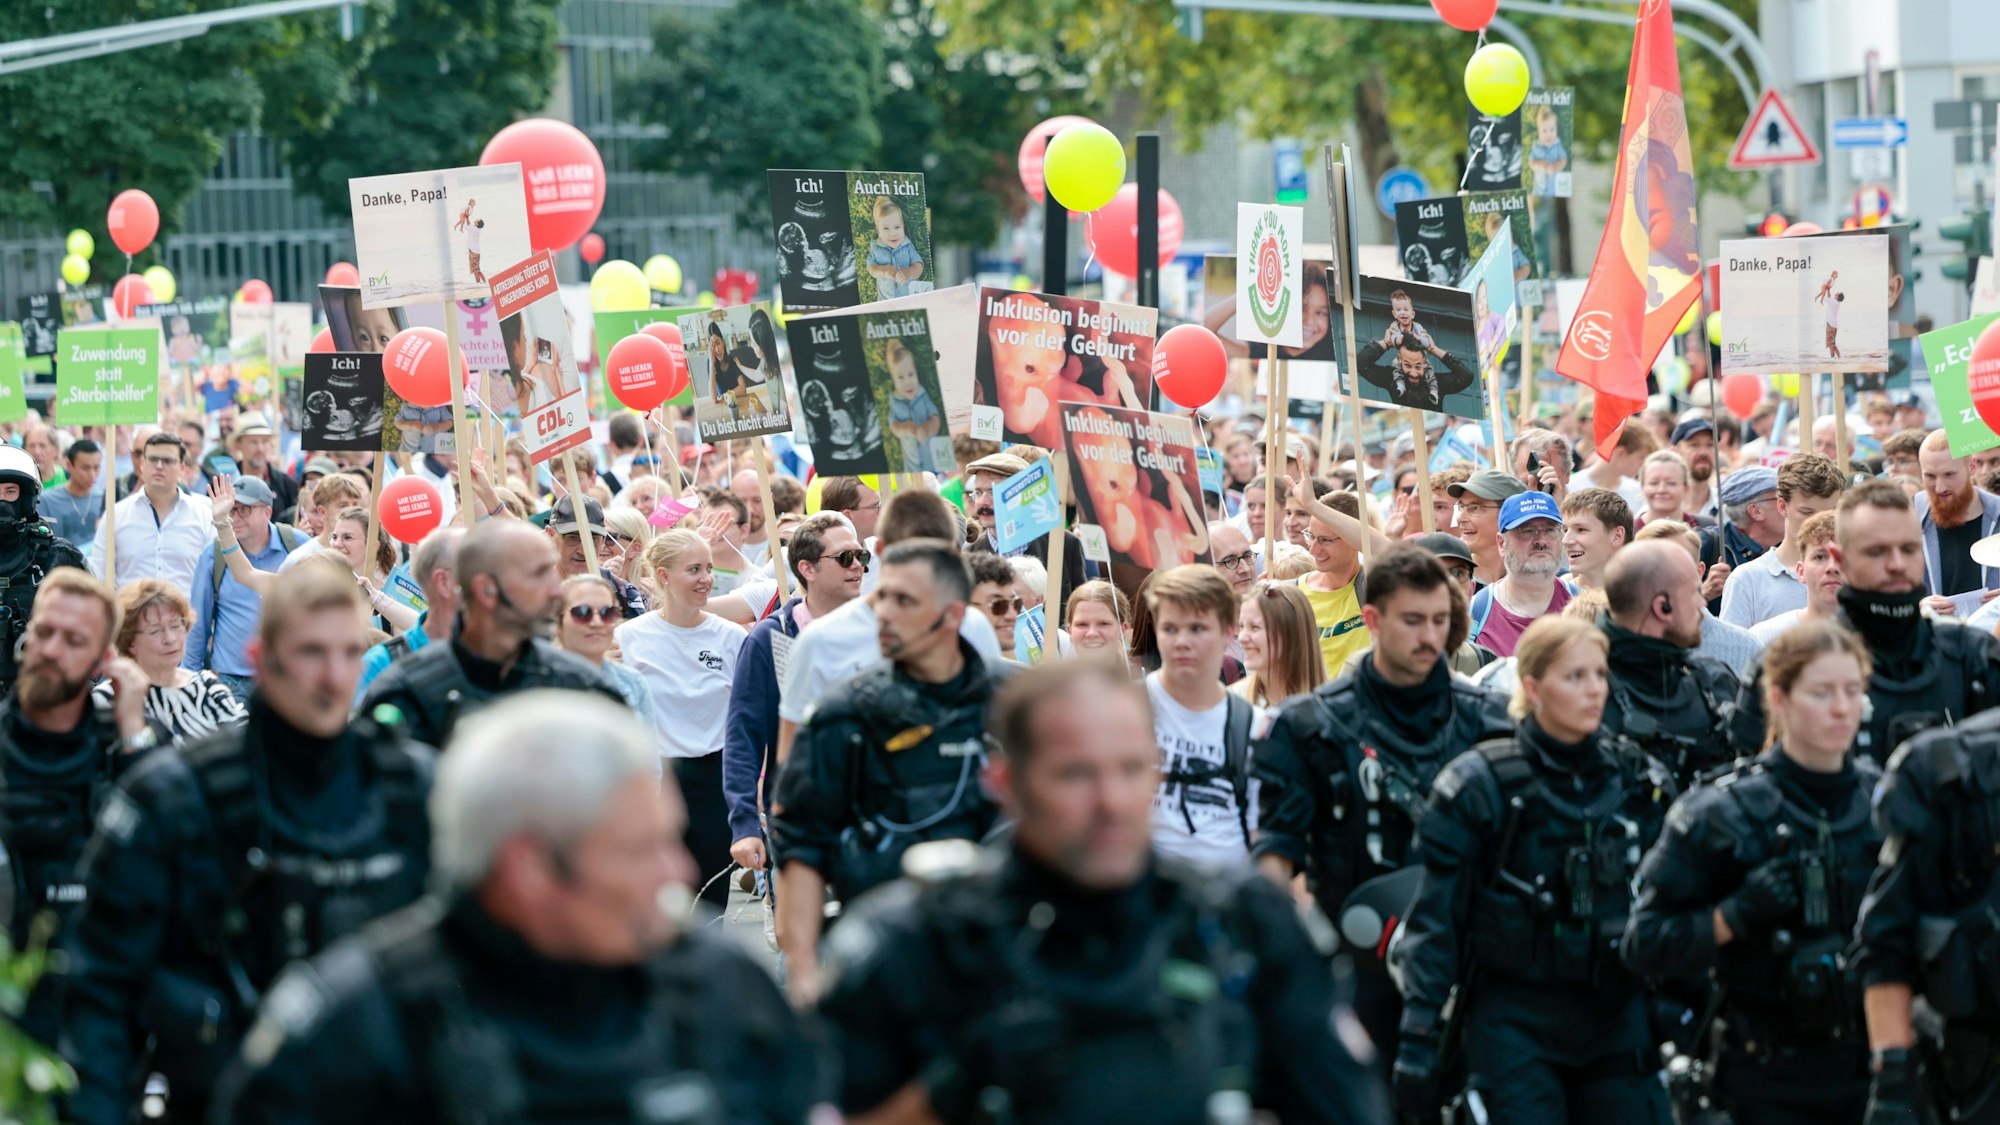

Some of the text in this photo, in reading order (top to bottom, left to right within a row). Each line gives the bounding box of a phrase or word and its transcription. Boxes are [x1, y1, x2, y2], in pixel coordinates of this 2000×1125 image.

[1552, 92, 1570, 106] ich!
[795, 178, 824, 193] Ich!
[854, 180, 919, 196] Auch ich!
[362, 186, 447, 207] Danke, Papa!
[1418, 203, 1444, 219] Ich!
[1469, 197, 1524, 213] Auch ich!
[1249, 210, 1290, 277] THANK YOU MOM!
[539, 258, 550, 272] EIN
[1730, 256, 1811, 272] Danke, Papa!
[534, 274, 550, 289] KIND
[986, 296, 1150, 337] Inklusion beginnt
[810, 324, 840, 344] Ich!
[865, 317, 926, 339] Auch ich!
[997, 328, 1136, 362] vor der Geburt
[71, 342, 146, 365] Zuwendung
[331, 358, 360, 370] Ich!
[619, 362, 652, 374] WIR LIEBEN
[95, 366, 122, 382] statt
[620, 372, 654, 384] DAS LEBEN!
[537, 406, 566, 436] CDL
[701, 410, 788, 437] Du bist nicht allein!
[1064, 411, 1190, 448] Inklusion beginnt
[1080, 443, 1106, 460] vor
[1110, 444, 1134, 465] der
[1136, 446, 1186, 474] Geburt
[410, 493, 428, 502] LIEBEN
[1024, 481, 1046, 501] LEBEN
[412, 501, 430, 510] LEBEN!
